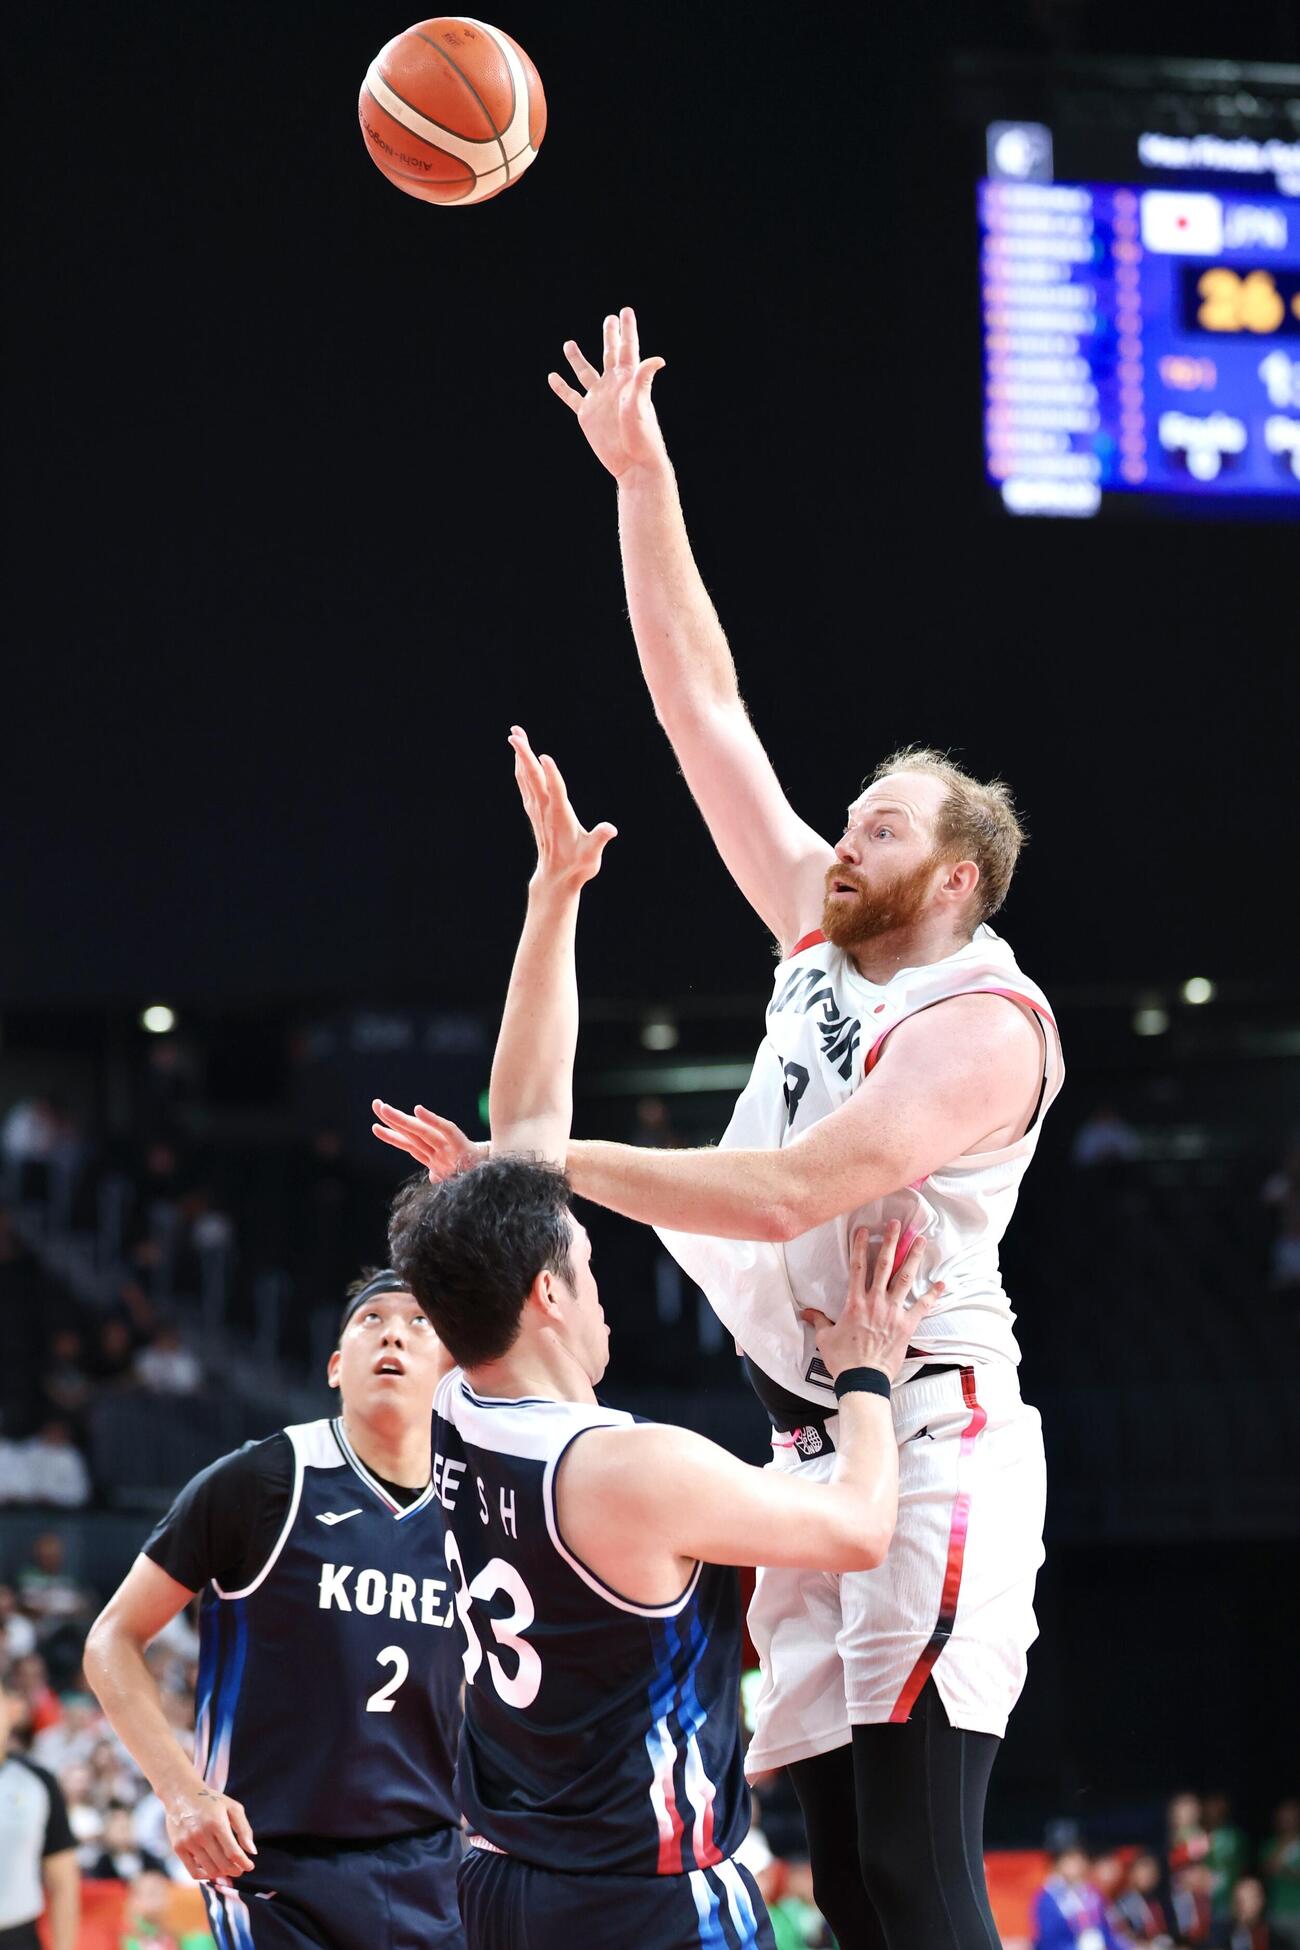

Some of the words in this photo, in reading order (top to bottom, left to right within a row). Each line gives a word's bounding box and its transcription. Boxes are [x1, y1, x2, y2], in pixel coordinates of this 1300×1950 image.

[477, 1476, 489, 1525] S
[500, 1487, 517, 1539] H
[366, 1645, 409, 1712] 2
